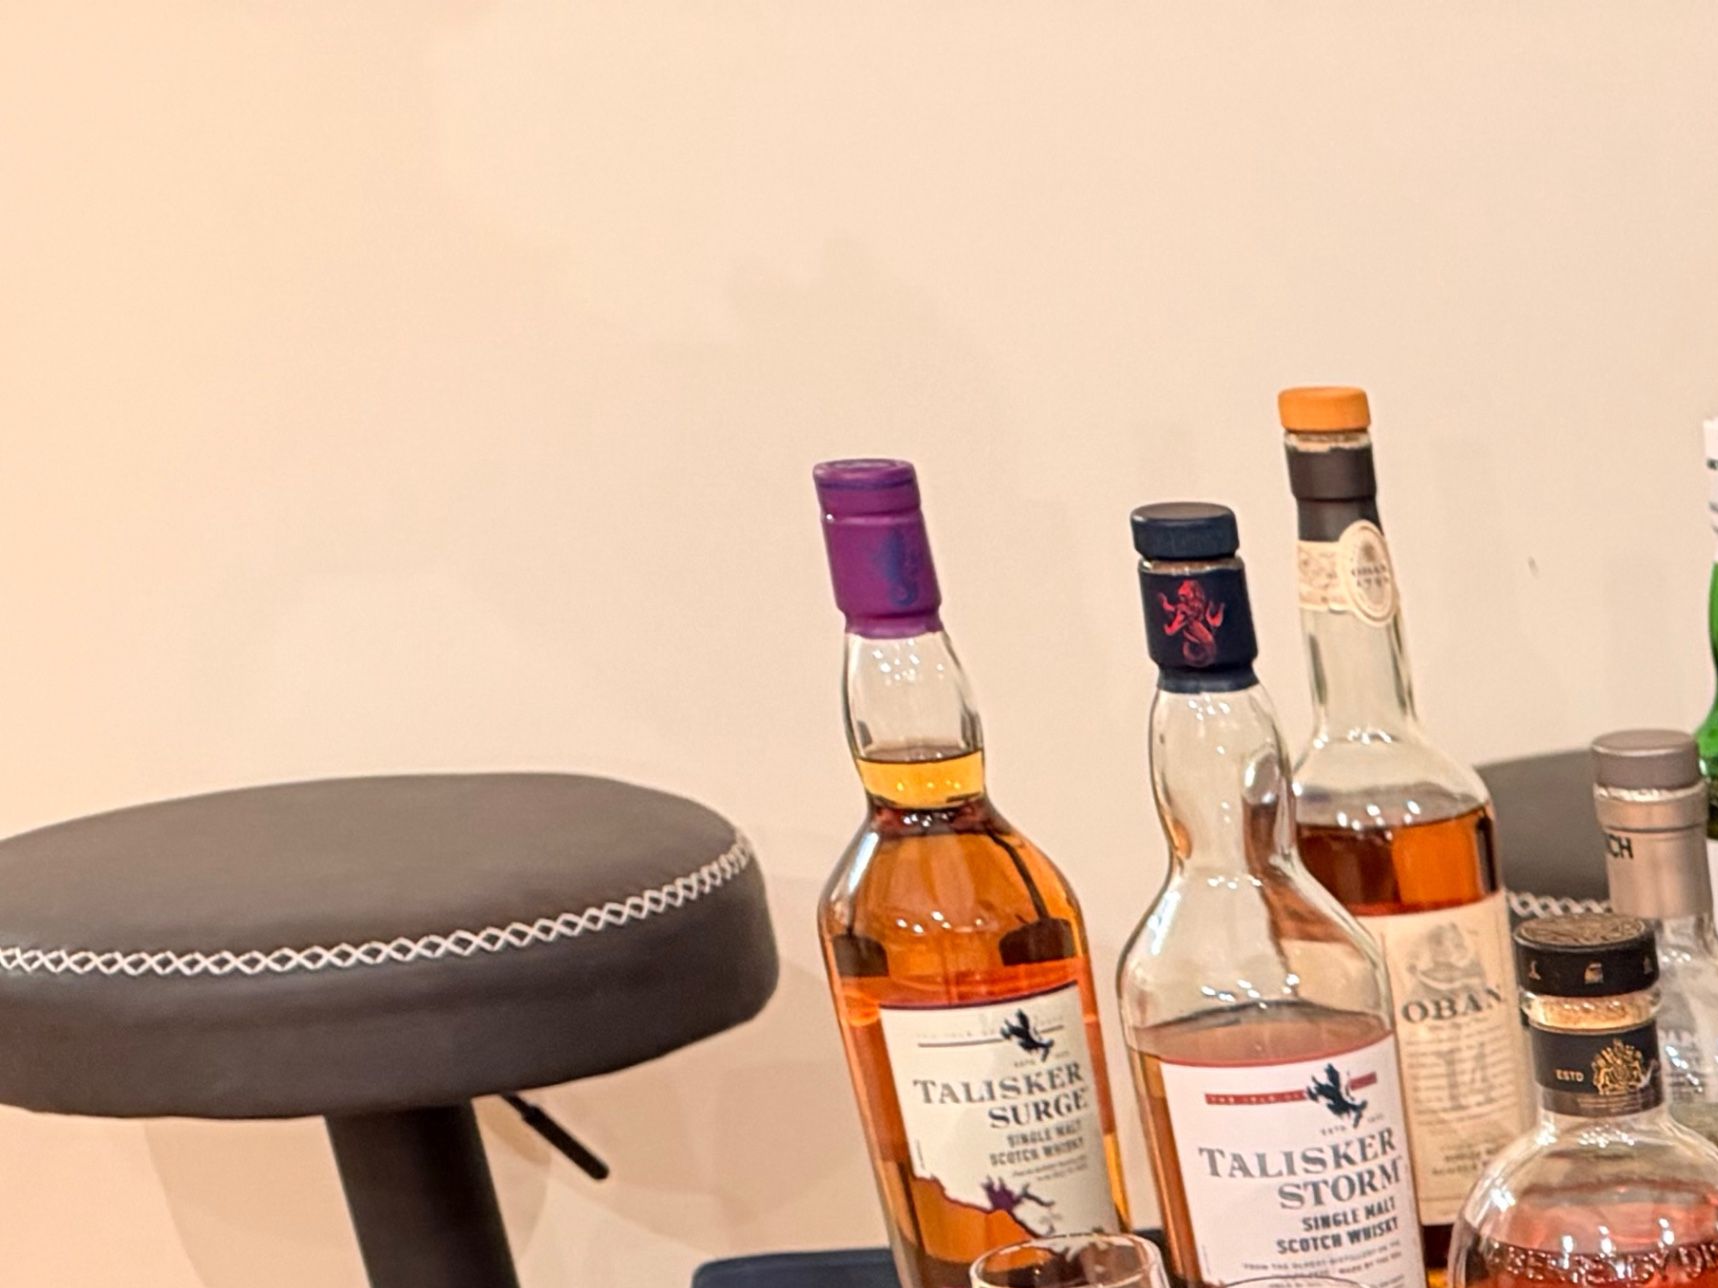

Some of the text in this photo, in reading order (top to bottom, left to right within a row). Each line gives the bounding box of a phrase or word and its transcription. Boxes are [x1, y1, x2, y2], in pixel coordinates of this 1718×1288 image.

[913, 1060, 1084, 1104] TALISKER
[1556, 1068, 1585, 1083] ESTD
[987, 1090, 1088, 1129] SURGE
[1007, 1118, 1082, 1148] SINGLE MALT
[1198, 1127, 1397, 1178] TALISKER
[989, 1147, 1039, 1167] SCOTCH
[1277, 1159, 1401, 1210] STORM
[1302, 1196, 1396, 1232] SINGLE MALT
[1276, 1216, 1399, 1255] SCOTCH WHISKY
